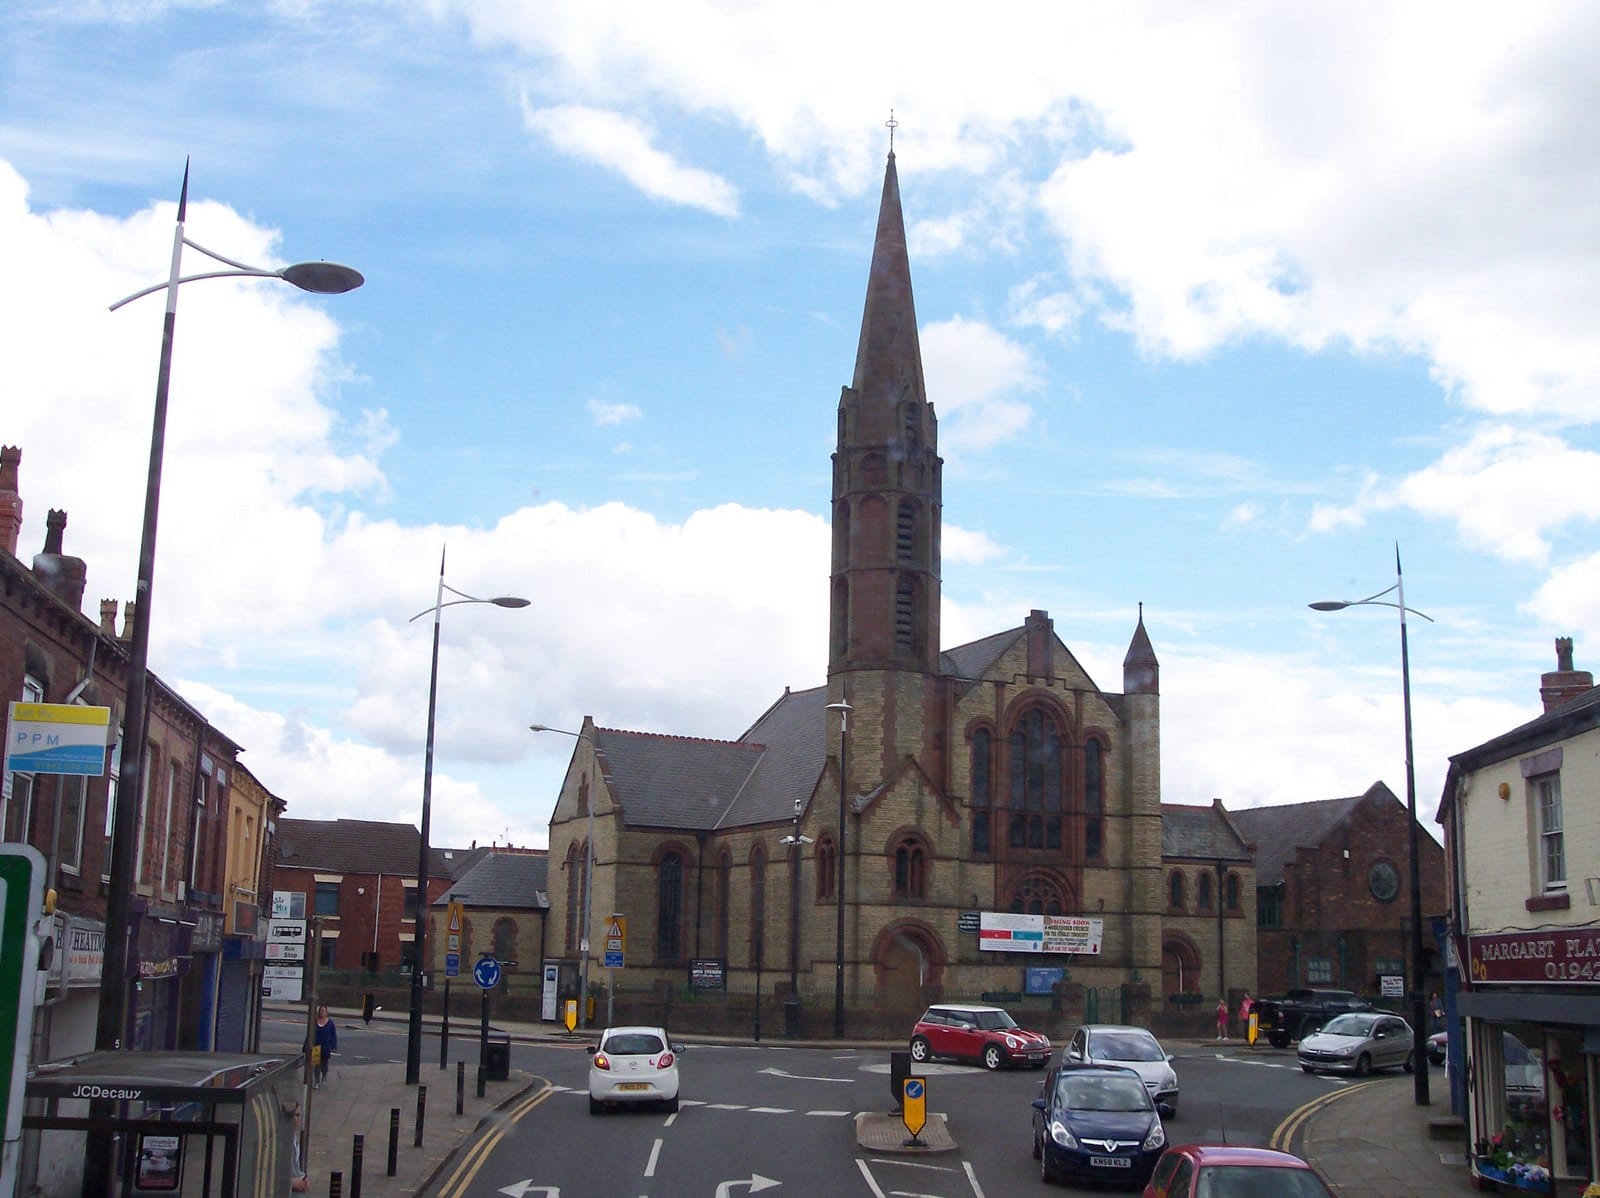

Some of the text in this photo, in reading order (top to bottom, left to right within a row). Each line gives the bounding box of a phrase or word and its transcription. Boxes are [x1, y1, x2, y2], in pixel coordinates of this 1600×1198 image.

[1482, 940, 1555, 961] MARGARET
[1545, 962, 1600, 979] 01942
[114, 1039, 121, 1049] 5
[73, 1085, 142, 1099] JCDecaux
